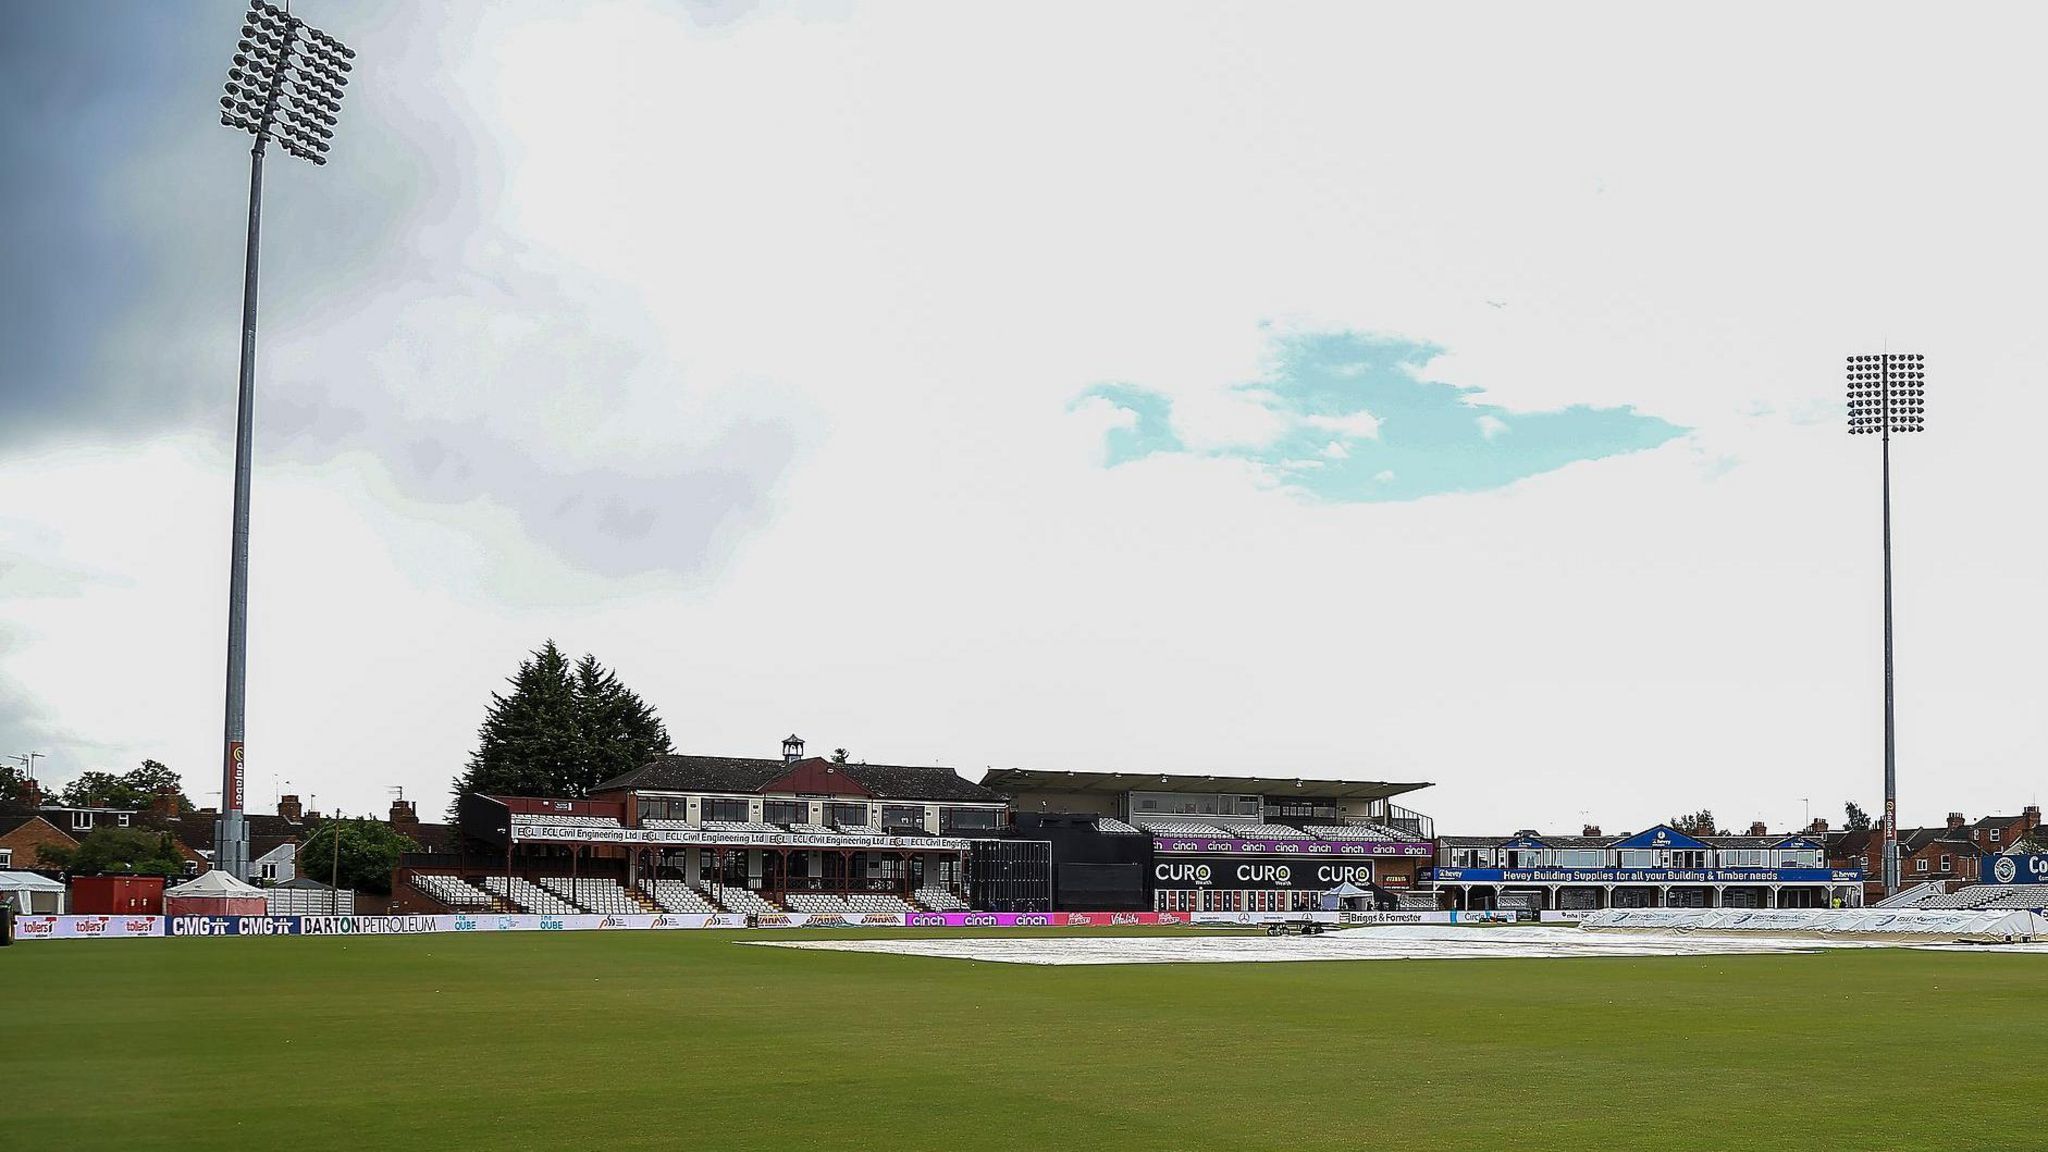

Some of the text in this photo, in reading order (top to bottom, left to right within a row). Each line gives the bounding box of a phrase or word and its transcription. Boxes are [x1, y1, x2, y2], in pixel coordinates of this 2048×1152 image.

[234, 762, 244, 806] dafabet
[518, 827, 537, 837] ECL
[542, 827, 558, 837] ECL
[560, 828, 575, 838] Civil
[577, 829, 624, 841] Engineering
[625, 830, 638, 840] Ltd
[642, 831, 660, 841] ECL
[666, 832, 681, 841] ECL
[683, 832, 700, 842] Civil
[702, 832, 750, 845] Engineering
[751, 833, 764, 843] Ltd
[793, 835, 807, 843] ECL
[808, 835, 825, 844] Civil
[826, 836, 871, 846] Engineering
[872, 837, 885, 845] Ltd
[911, 838, 925, 846] ECL
[925, 838, 941, 847] Civil
[1172, 840, 1198, 850] cinch
[1207, 840, 1232, 851] cinch
[1241, 841, 1266, 851] cinch
[1275, 842, 1299, 852] cinch
[1308, 842, 1332, 853] cinch
[1341, 843, 1364, 853] cinch
[1373, 844, 1396, 854] cinch
[1404, 845, 1427, 855] cinch
[1155, 864, 1212, 881] CURO
[1236, 864, 1291, 881] CURO
[1317, 866, 1370, 882] CURO
[1503, 871, 1778, 882] Hevey Building Supplies for all your Building & Timber needs
[912, 914, 946, 926] cinch
[964, 914, 997, 926] cinch
[1016, 914, 1048, 926] cinch
[1111, 913, 1140, 925] Vitality
[1350, 914, 1422, 923] Briggs & Forrester
[24, 921, 48, 933] tollers
[76, 921, 101, 932] tollers
[126, 921, 149, 932] tollers
[172, 917, 210, 935] CMG
[238, 917, 274, 935] CMG
[363, 917, 437, 932] PETROLEUM
[454, 921, 477, 930] QUBE
[540, 921, 564, 930] QUBE
